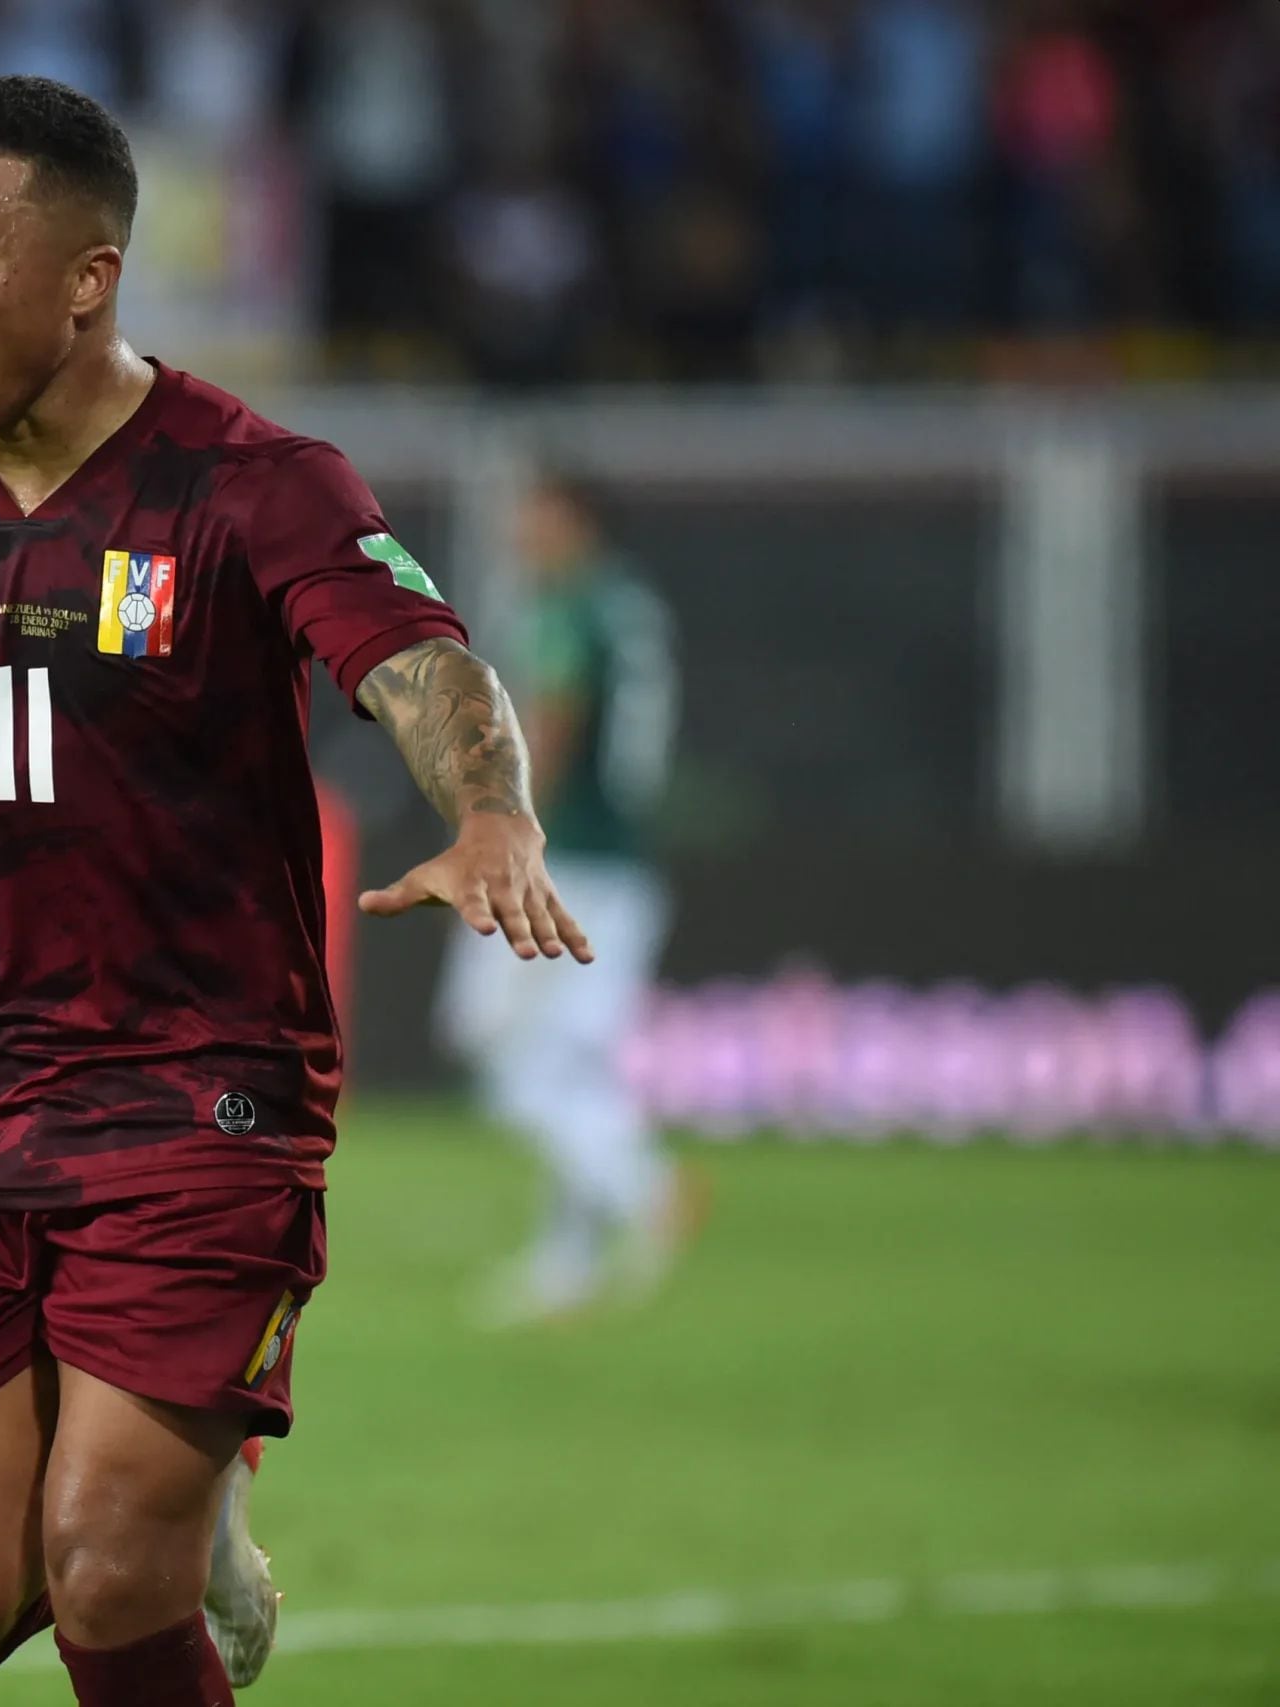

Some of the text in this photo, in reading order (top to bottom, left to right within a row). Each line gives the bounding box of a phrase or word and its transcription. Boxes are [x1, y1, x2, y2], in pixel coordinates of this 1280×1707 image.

[108, 558, 171, 588] FVF
[21, 615, 48, 626] ENERO
[53, 608, 88, 623] BOLIVIA
[21, 626, 56, 638] BARINAS
